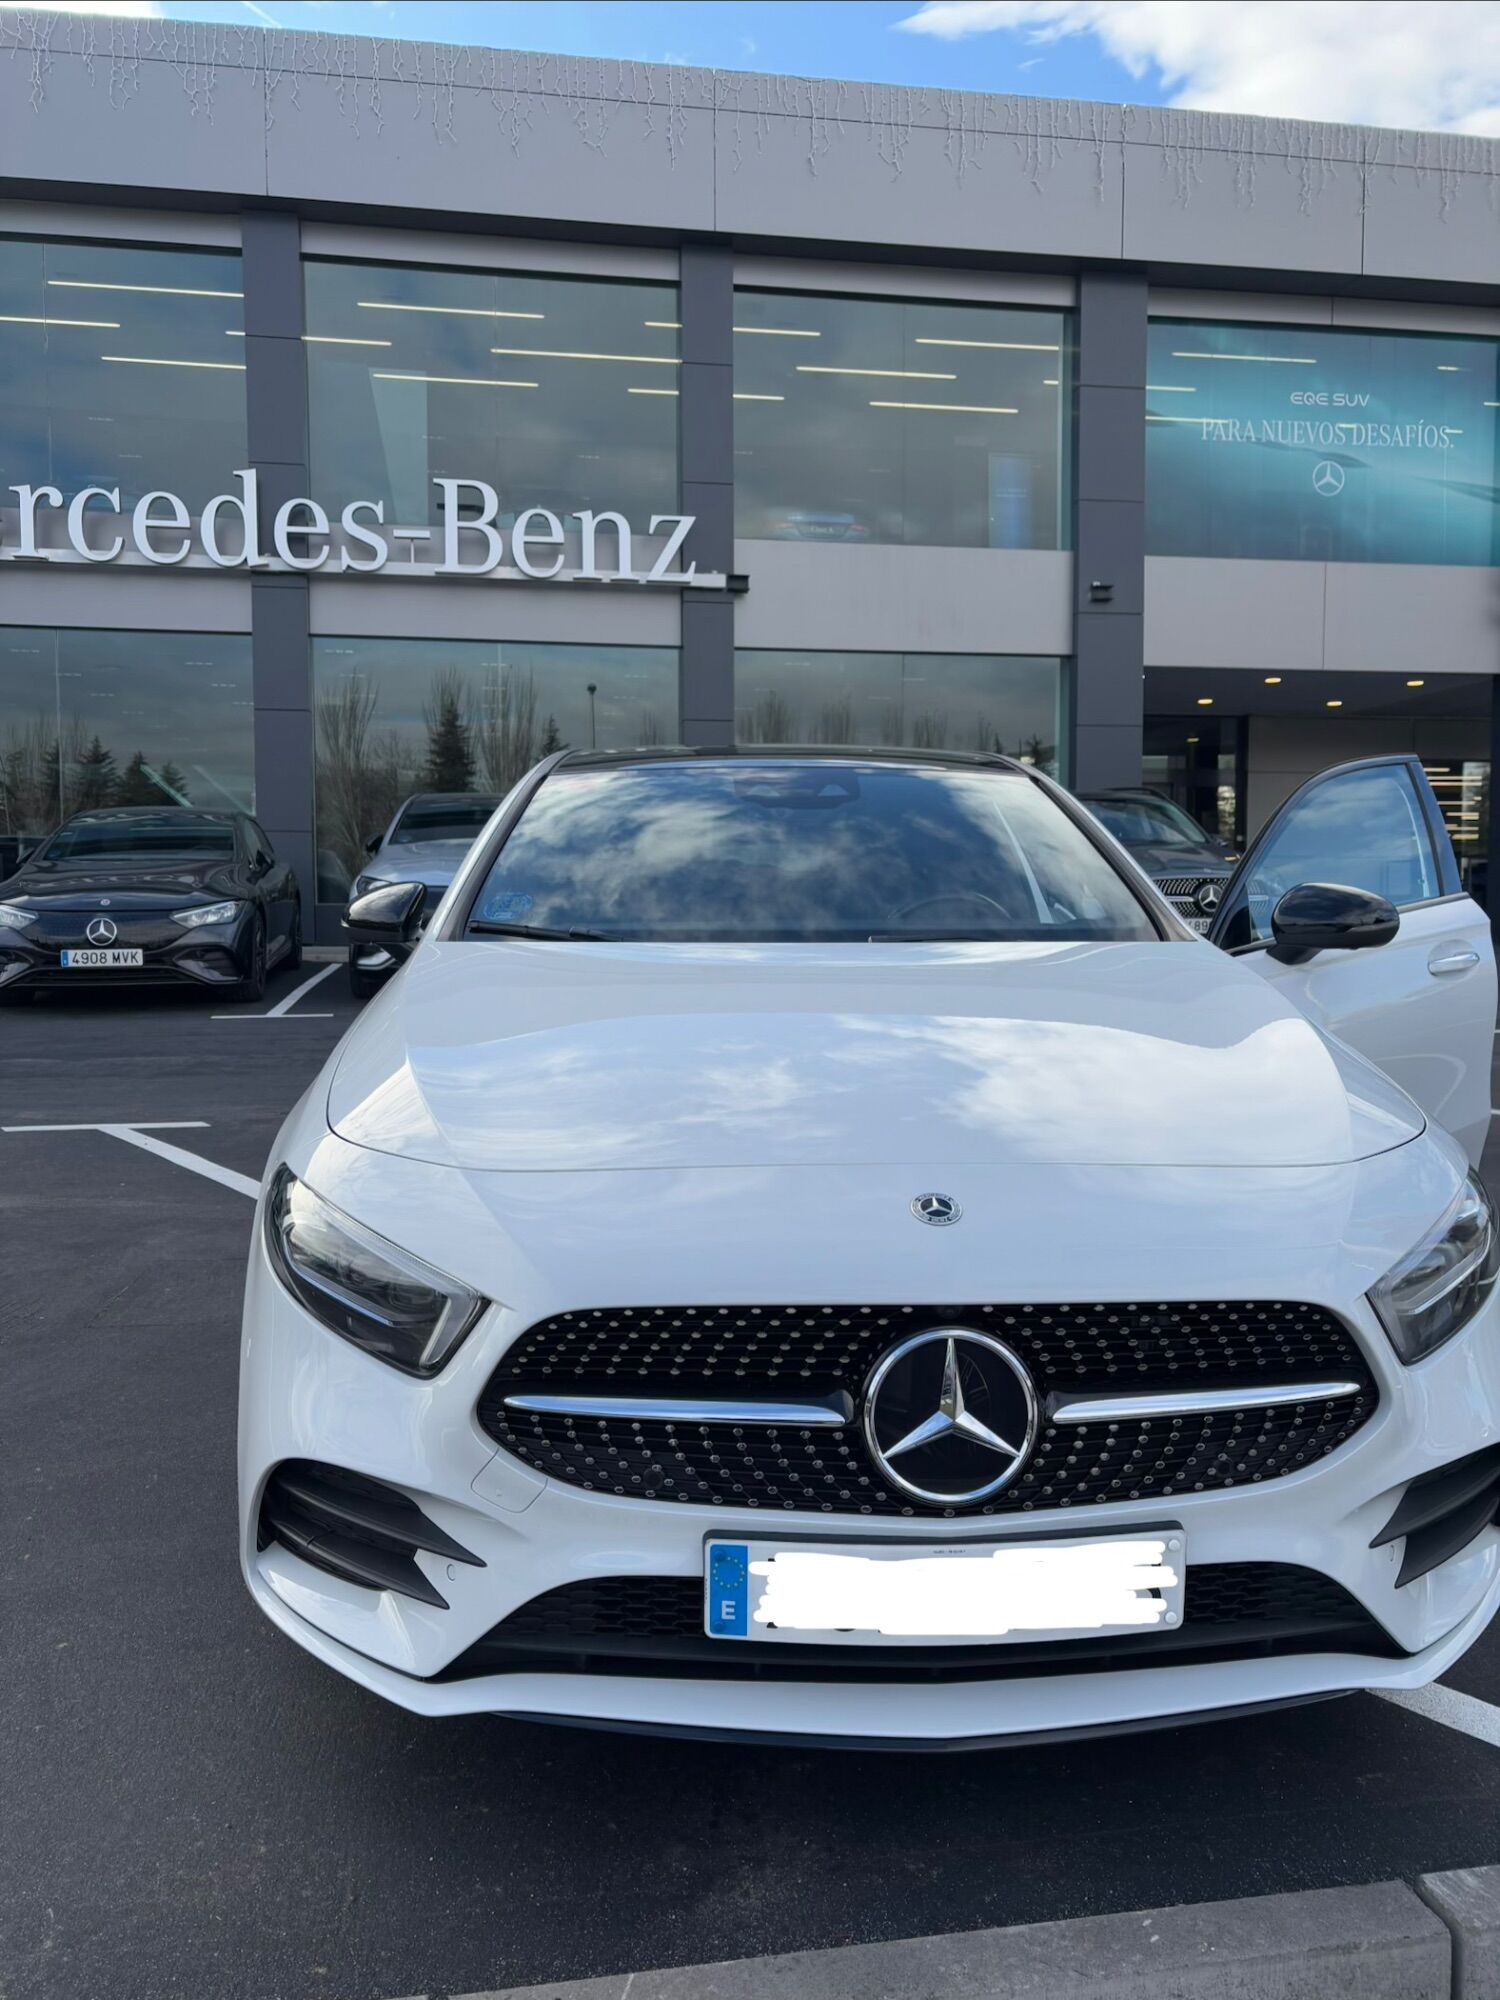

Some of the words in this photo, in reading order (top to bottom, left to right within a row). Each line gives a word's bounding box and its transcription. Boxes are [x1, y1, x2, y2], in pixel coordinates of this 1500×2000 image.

[1290, 391, 1329, 406] EQE
[1332, 393, 1370, 407] SUV
[1200, 418, 1256, 442] PARA
[1261, 419, 1346, 446] NUEVOS
[1351, 419, 1454, 448] DESAFÍOS.
[3, 468, 698, 584] rcedes-Benz
[1188, 920, 1209, 931] 89
[72, 951, 107, 965] 4908
[112, 951, 139, 965] MVK
[721, 1600, 736, 1620] E
